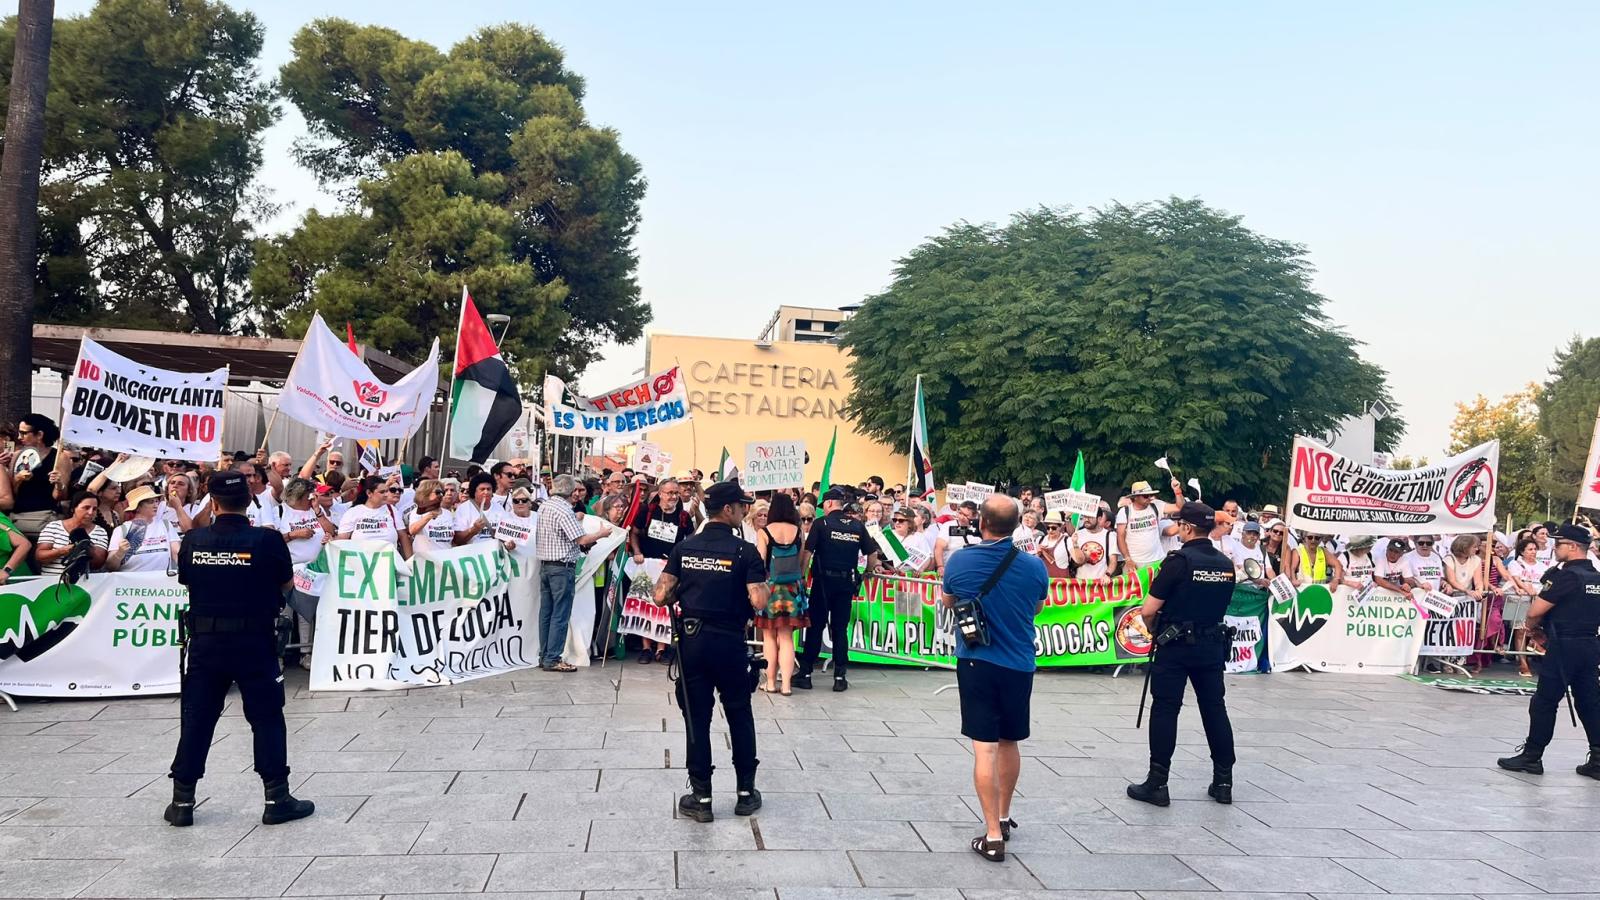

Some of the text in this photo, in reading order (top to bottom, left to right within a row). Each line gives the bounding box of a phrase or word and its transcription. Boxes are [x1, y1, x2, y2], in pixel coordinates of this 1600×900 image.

[78, 359, 224, 408] NO MACROPLANTA
[691, 360, 839, 390] CAFETERIA
[71, 386, 216, 443] BIOMETANO
[328, 395, 373, 420] AQUÍ
[689, 391, 850, 420] RESTAURAN
[552, 399, 685, 433] ES UN DERECHO
[749, 459, 788, 472] PLANTA
[1293, 446, 1334, 492] NO
[747, 472, 803, 487] BIOMETANO
[1331, 469, 1445, 504] DE BIOMETANO
[1300, 506, 1429, 523] PLATAFORMA DE SANTA AMALIA
[498, 527, 529, 540] BIOMETANO
[192, 551, 238, 559] POLICIA
[192, 558, 251, 566] NACIONAL
[681, 556, 721, 565] POLICIA
[681, 562, 732, 573] NACIONAL
[115, 587, 188, 597] EXTREMADUR
[116, 602, 189, 620] SANI
[1347, 605, 1418, 620] SANIDAD
[113, 623, 183, 647] PÚBL
[852, 620, 866, 650] A
[871, 620, 898, 654] LA
[1346, 619, 1414, 638] PÚBLICA
